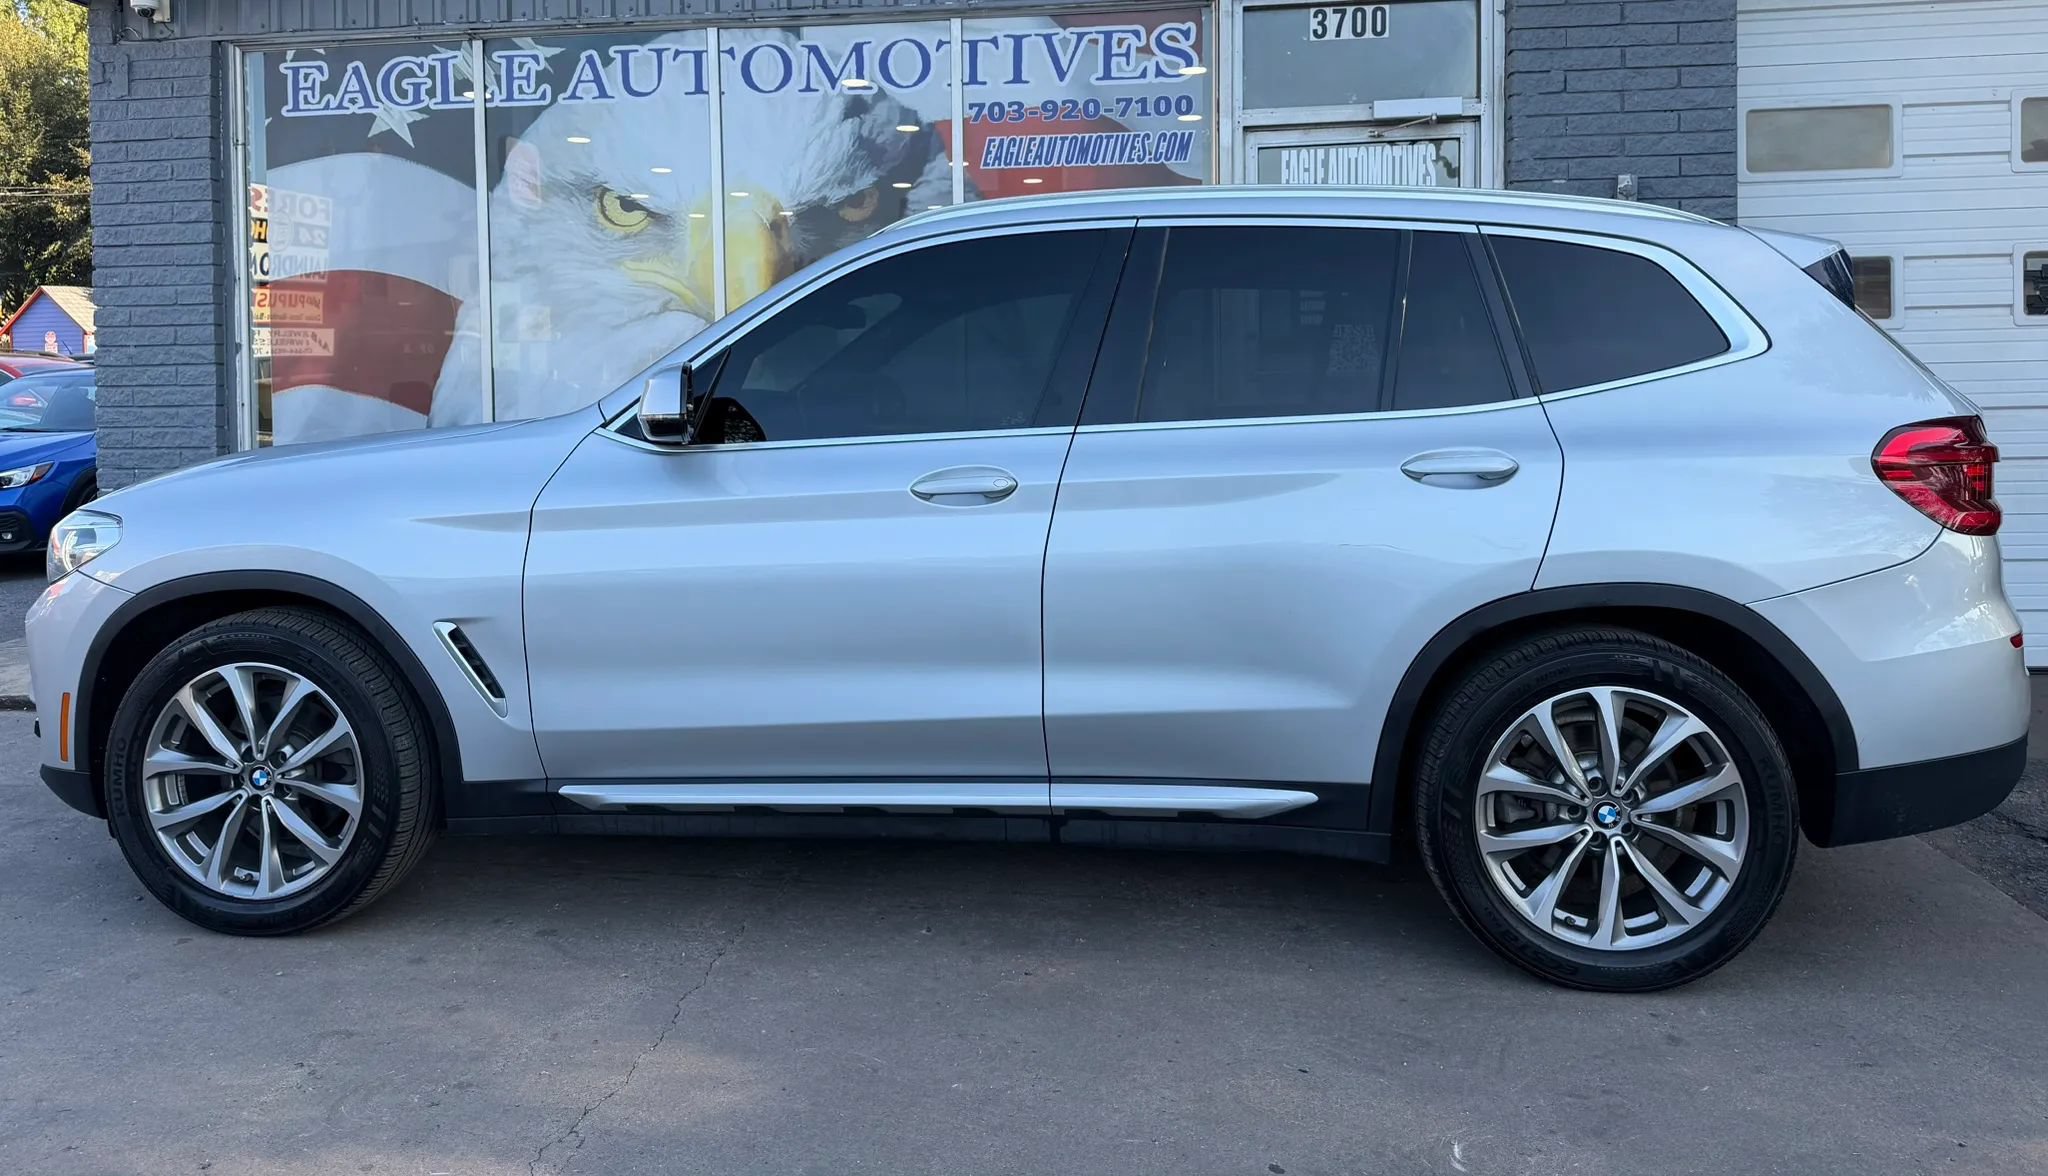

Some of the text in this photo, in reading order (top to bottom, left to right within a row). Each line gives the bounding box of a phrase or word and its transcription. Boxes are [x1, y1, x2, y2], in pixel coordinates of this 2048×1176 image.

[1312, 6, 1387, 39] 3700
[282, 23, 1200, 116] EAGLE AUTOMOTIVES
[968, 95, 1195, 124] 703-920-7100
[980, 130, 1196, 169] EAGLEAUTOMOTIVES.COM
[1281, 143, 1436, 186] EAGLE AUTOMOTIVES
[111, 737, 127, 818] KUMHO
